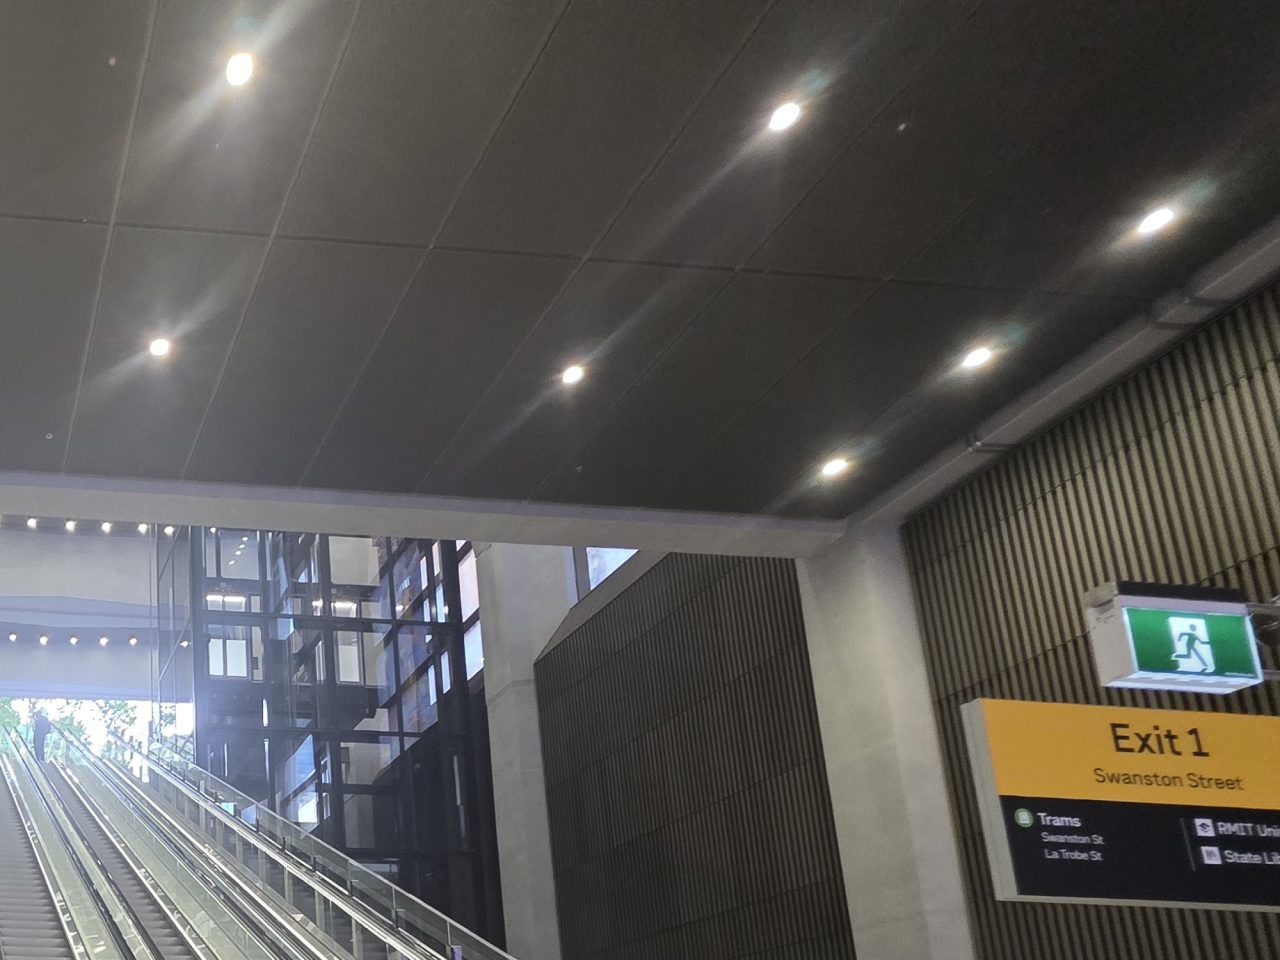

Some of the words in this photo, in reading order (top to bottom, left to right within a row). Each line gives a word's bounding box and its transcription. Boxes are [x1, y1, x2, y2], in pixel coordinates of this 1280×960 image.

[1110, 723, 1182, 756] Exit
[1187, 728, 1210, 758] 1
[1093, 768, 1183, 787] Swanston
[1185, 773, 1245, 791] Street
[1036, 812, 1082, 828] Trams
[1216, 821, 1254, 836] RMIT
[1040, 832, 1091, 844] Swanston
[1091, 834, 1105, 845] St
[1044, 848, 1059, 859] La
[1059, 849, 1089, 860] Trobe
[1089, 850, 1104, 861] St
[1223, 850, 1262, 864] State
